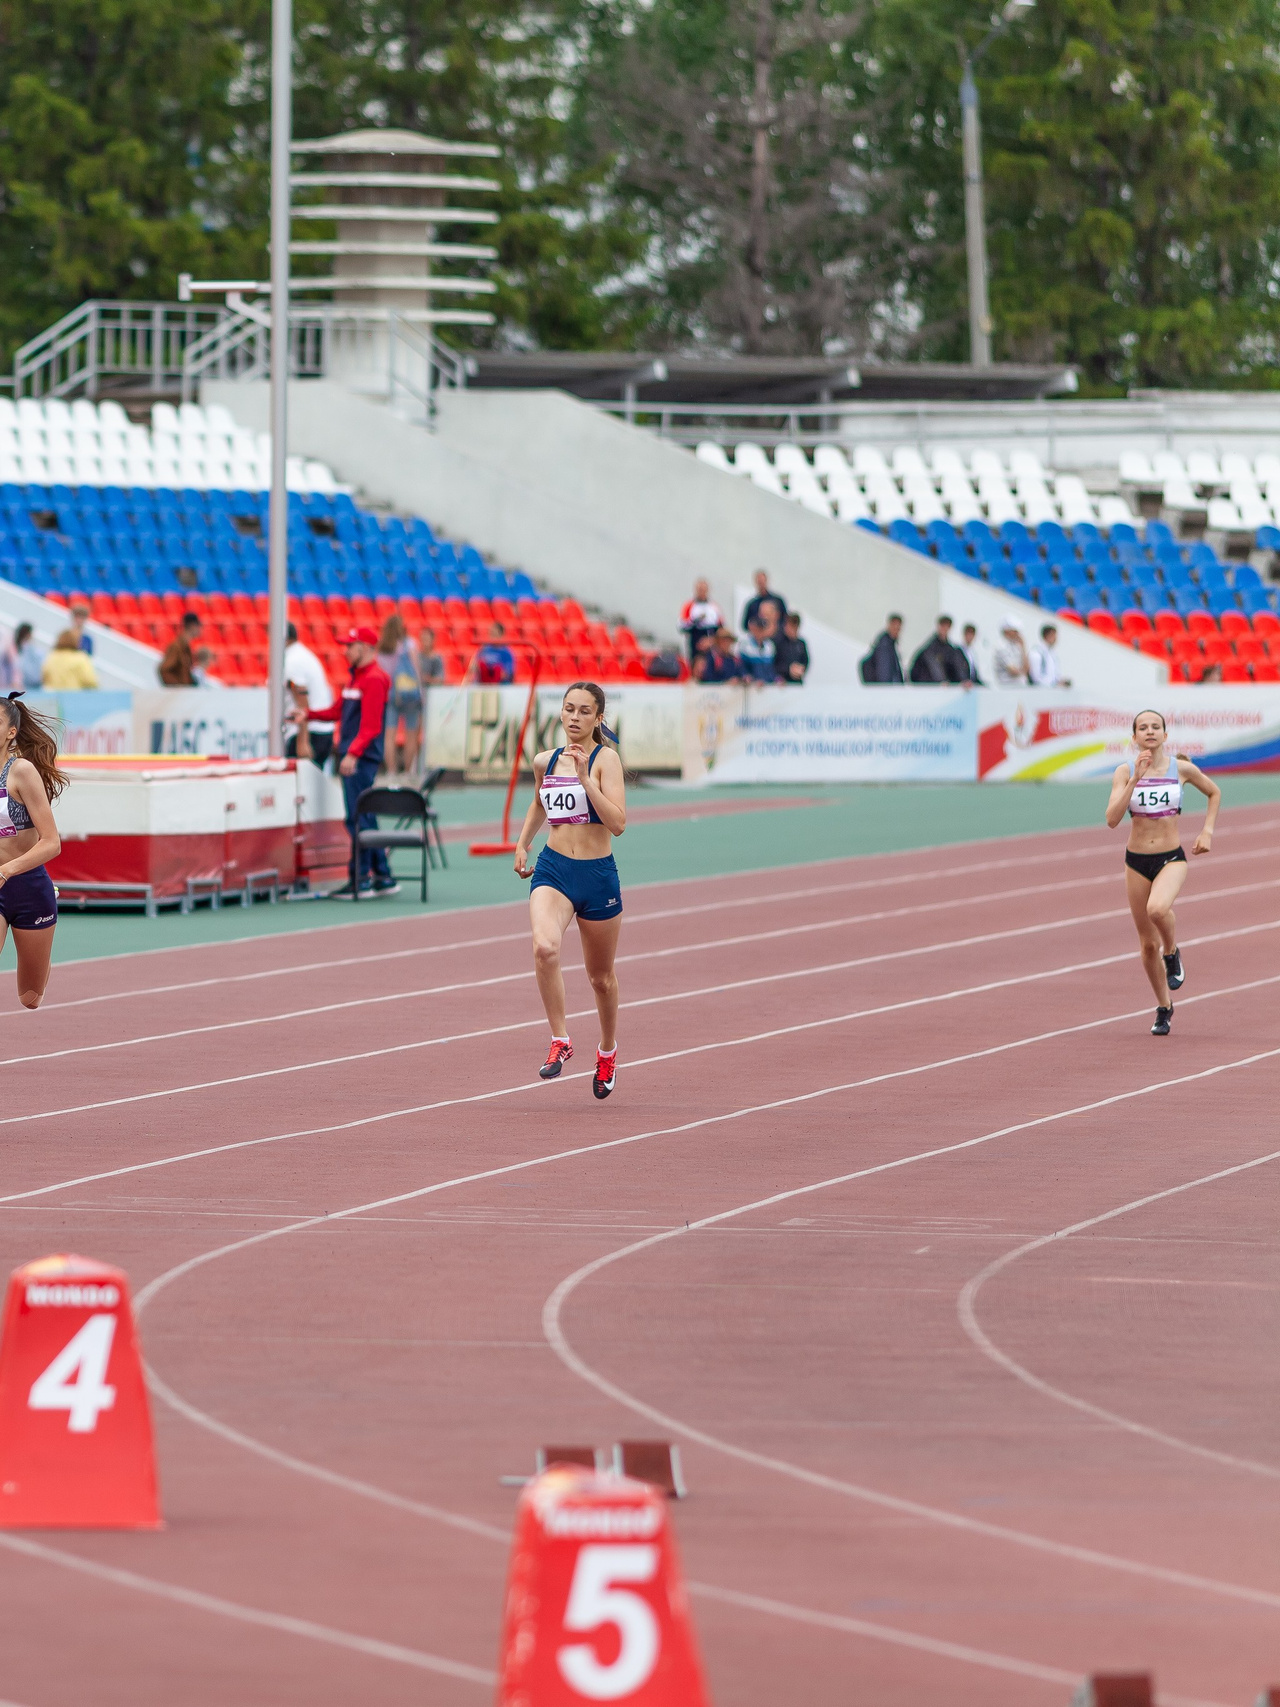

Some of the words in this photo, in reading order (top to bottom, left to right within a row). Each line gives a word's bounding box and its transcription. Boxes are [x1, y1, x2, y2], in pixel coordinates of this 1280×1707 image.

[544, 793, 576, 810] 140
[1137, 791, 1170, 806] 154
[26, 1283, 119, 1307] MONDO
[27, 1313, 118, 1433] 4
[555, 1543, 661, 1702] 5
